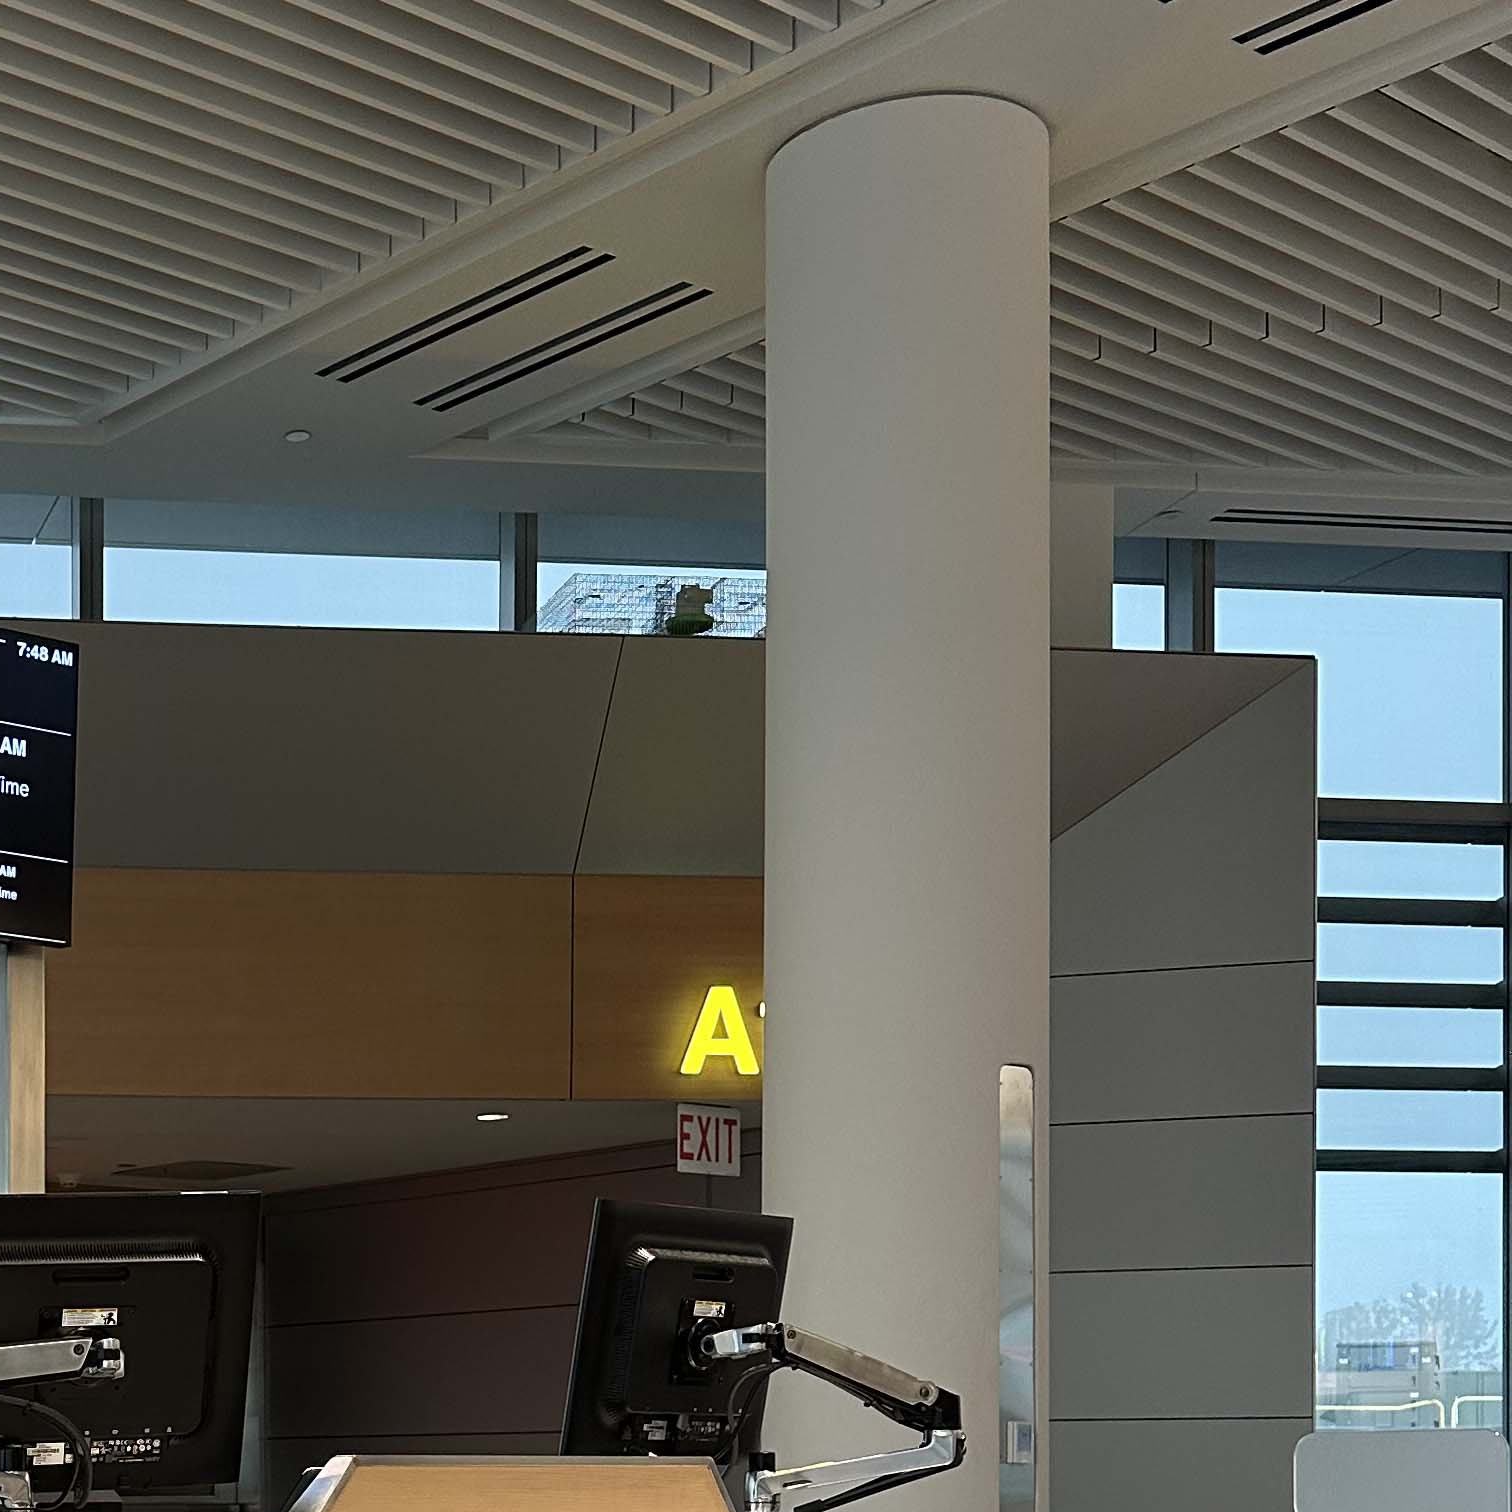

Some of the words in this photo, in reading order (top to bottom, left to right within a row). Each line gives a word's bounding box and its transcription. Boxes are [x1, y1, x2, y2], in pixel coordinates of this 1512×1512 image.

[17, 642, 49, 662] 7:48
[51, 647, 74, 667] AM
[0, 735, 27, 758] AM
[0, 864, 17, 879] AM
[680, 986, 766, 1075] A
[679, 1115, 737, 1165] EXIT
